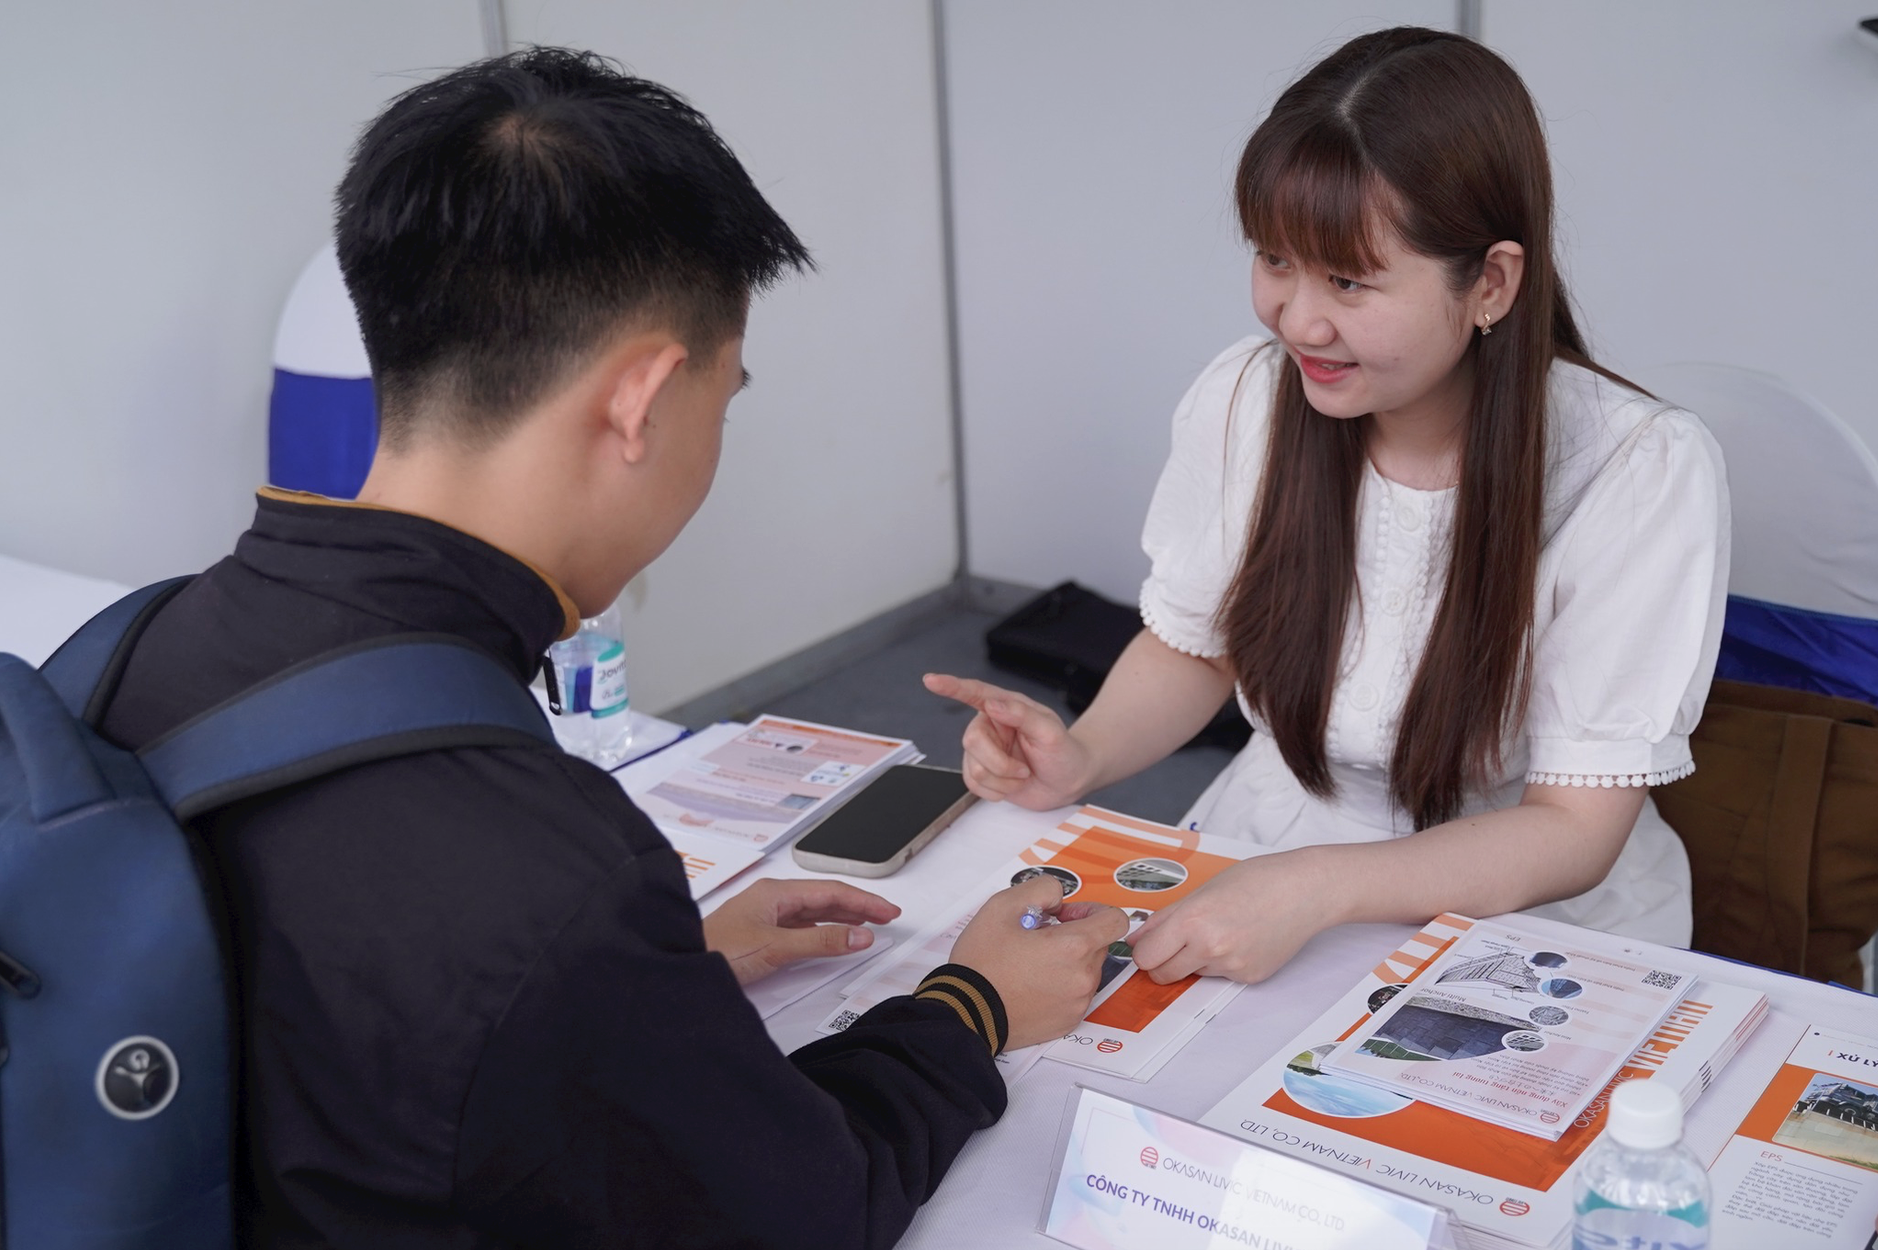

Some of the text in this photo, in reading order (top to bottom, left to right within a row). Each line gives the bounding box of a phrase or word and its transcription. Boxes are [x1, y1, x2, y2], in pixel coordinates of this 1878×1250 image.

[1500, 1100, 1538, 1116] OKASAN
[1302, 1140, 1372, 1170] VIETNAM
[1760, 1150, 1783, 1162] EPS
[1163, 1158, 1212, 1184] OKASAN
[1213, 1174, 1241, 1196] LIVIC
[1246, 1184, 1297, 1214] VIETNAM
[1376, 1164, 1418, 1183] LIVIC
[1418, 1177, 1494, 1205] OKASAN
[1086, 1172, 1128, 1200] CÔNG
[1132, 1190, 1150, 1206] TY
[1153, 1198, 1195, 1224] TNHH
[1198, 1215, 1262, 1248] OKASAN
